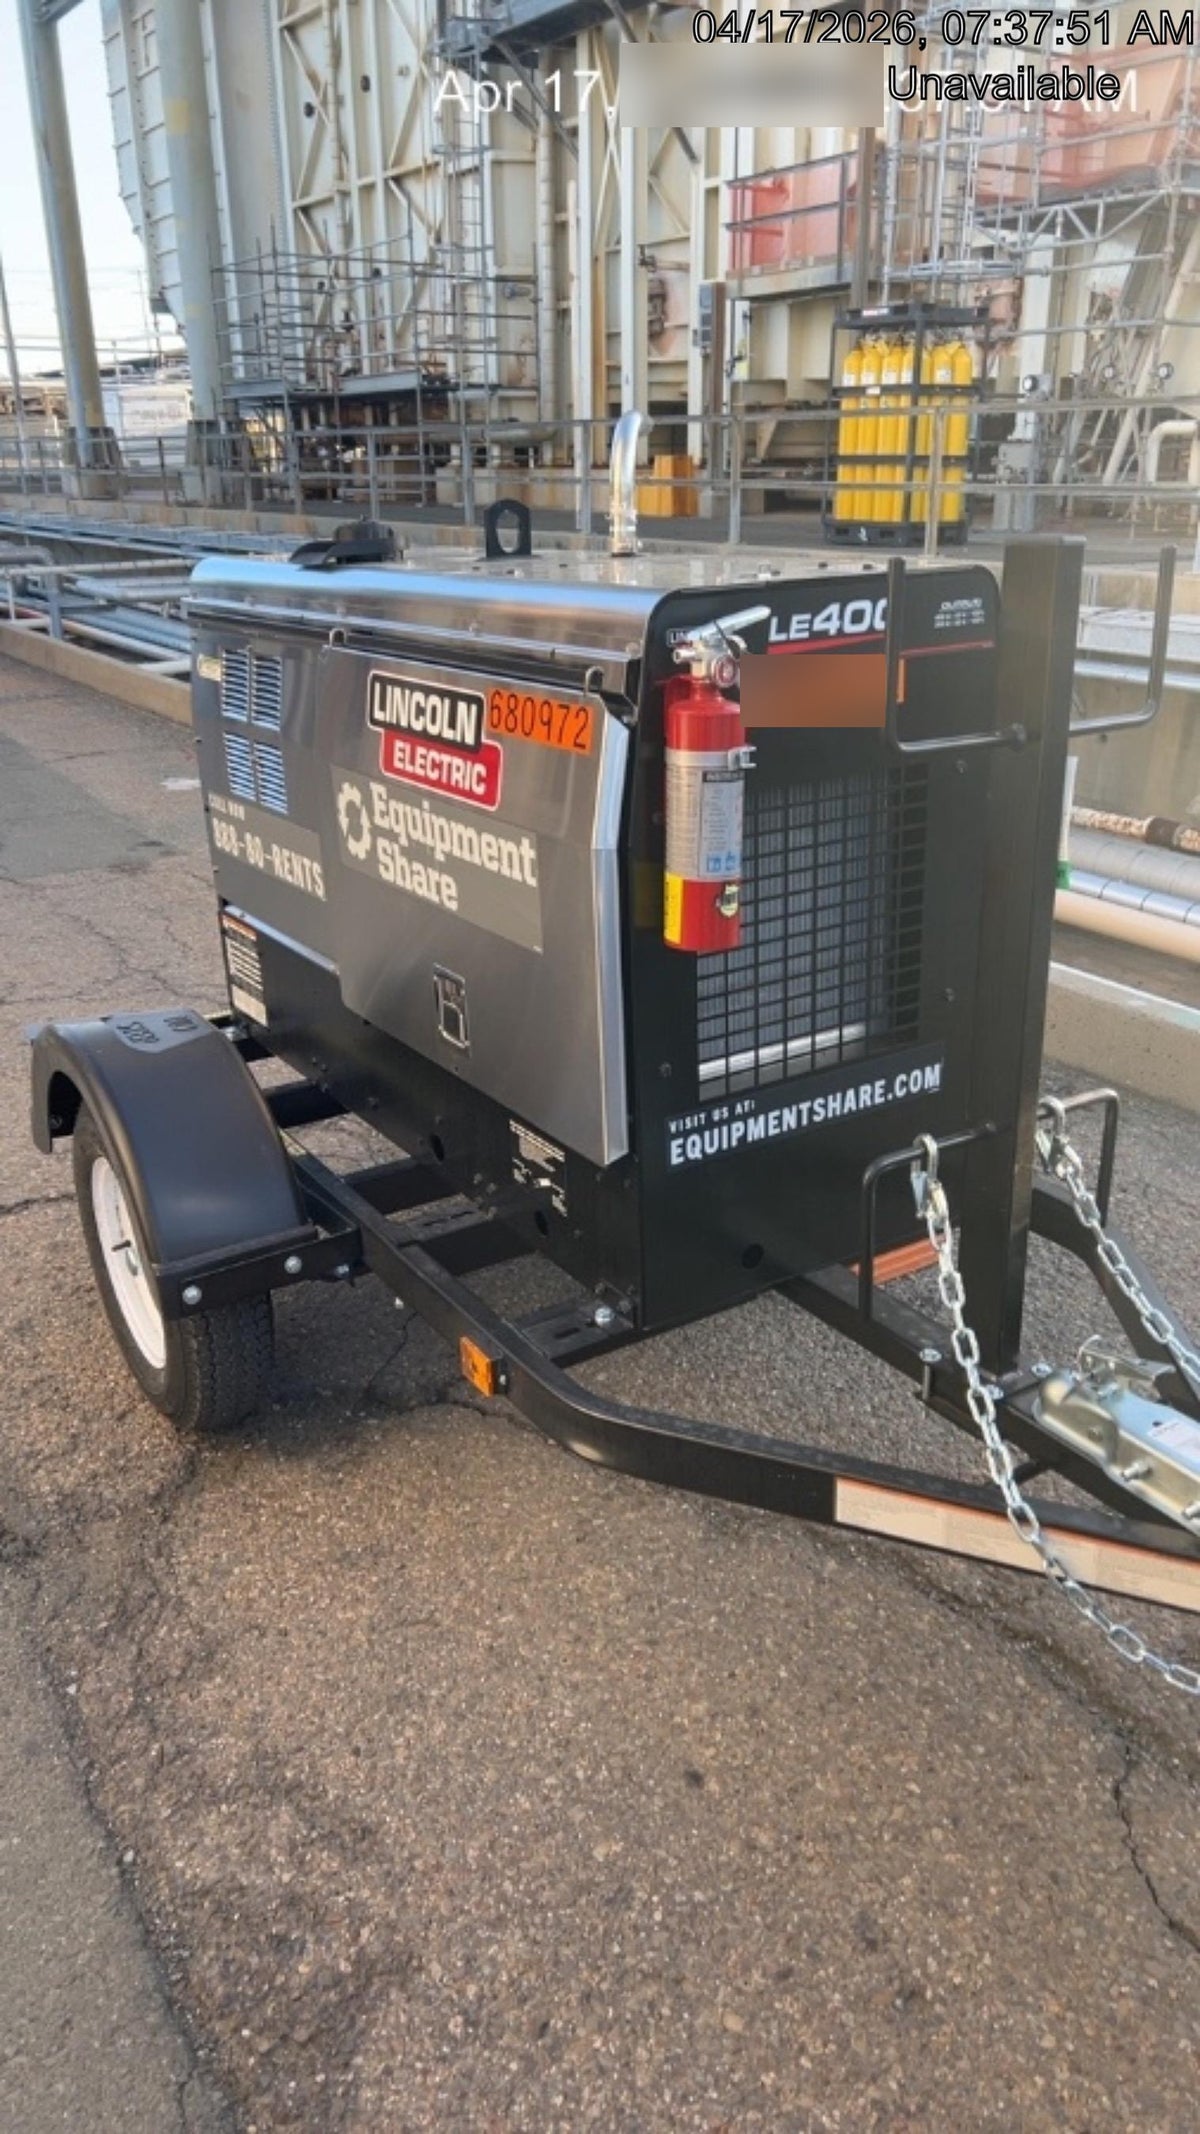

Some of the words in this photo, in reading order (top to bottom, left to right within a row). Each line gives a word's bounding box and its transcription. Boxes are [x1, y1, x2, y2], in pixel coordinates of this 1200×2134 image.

[373, 680, 479, 746] LINCOLN
[489, 690, 591, 750] 680972
[393, 740, 487, 796] ELECTRIC
[369, 782, 538, 888] Equipment
[376, 838, 459, 912] Share
[669, 1063, 941, 1166] EQUIPMENTSHARE.COM
[669, 1113, 706, 1134] VISIT
[712, 1107, 729, 1122] US
